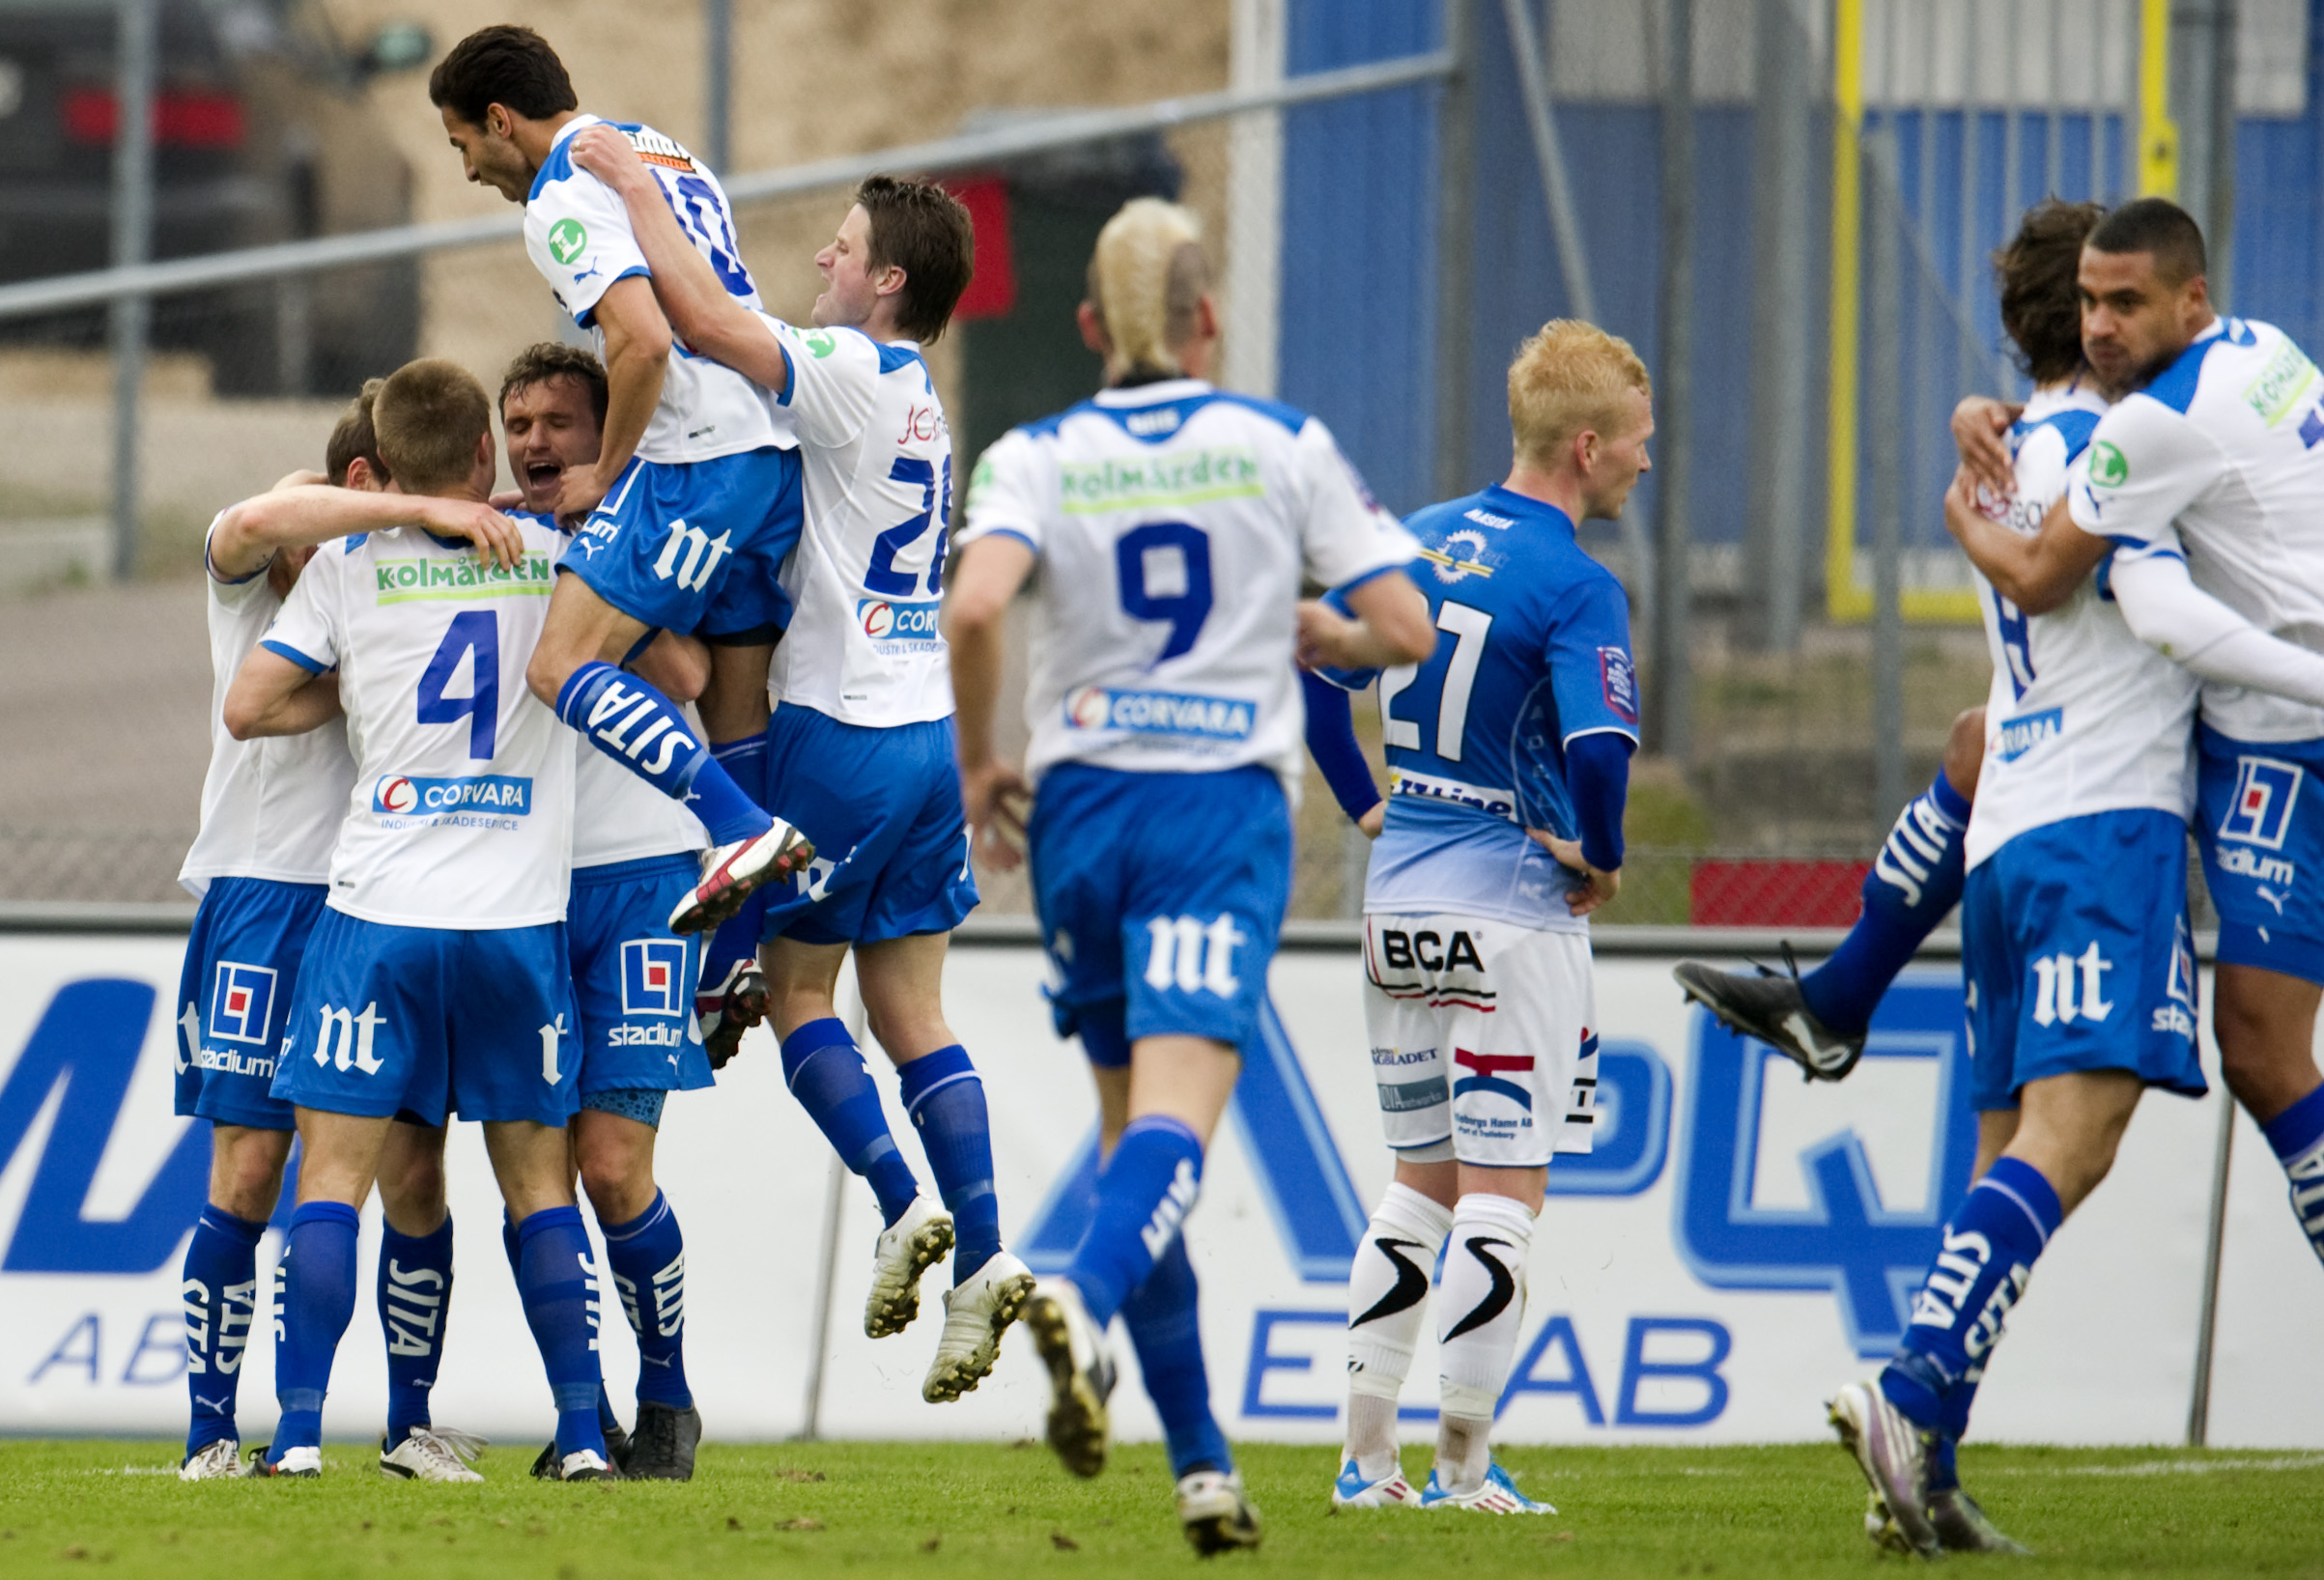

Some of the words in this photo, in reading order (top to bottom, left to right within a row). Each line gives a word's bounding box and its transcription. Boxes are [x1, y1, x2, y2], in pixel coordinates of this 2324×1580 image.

[1117, 521, 1213, 670] 9
[416, 609, 498, 760] 4
[587, 680, 695, 775] SITA
[1112, 693, 1249, 735] CORVARA
[424, 782, 524, 808] CORVARA
[1875, 796, 1951, 908] SITA
[1382, 929, 1485, 973] BCA
[388, 1257, 444, 1358] SITA
[1912, 1223, 1992, 1330] SITA
[1490, 1314, 1733, 1427] AB
